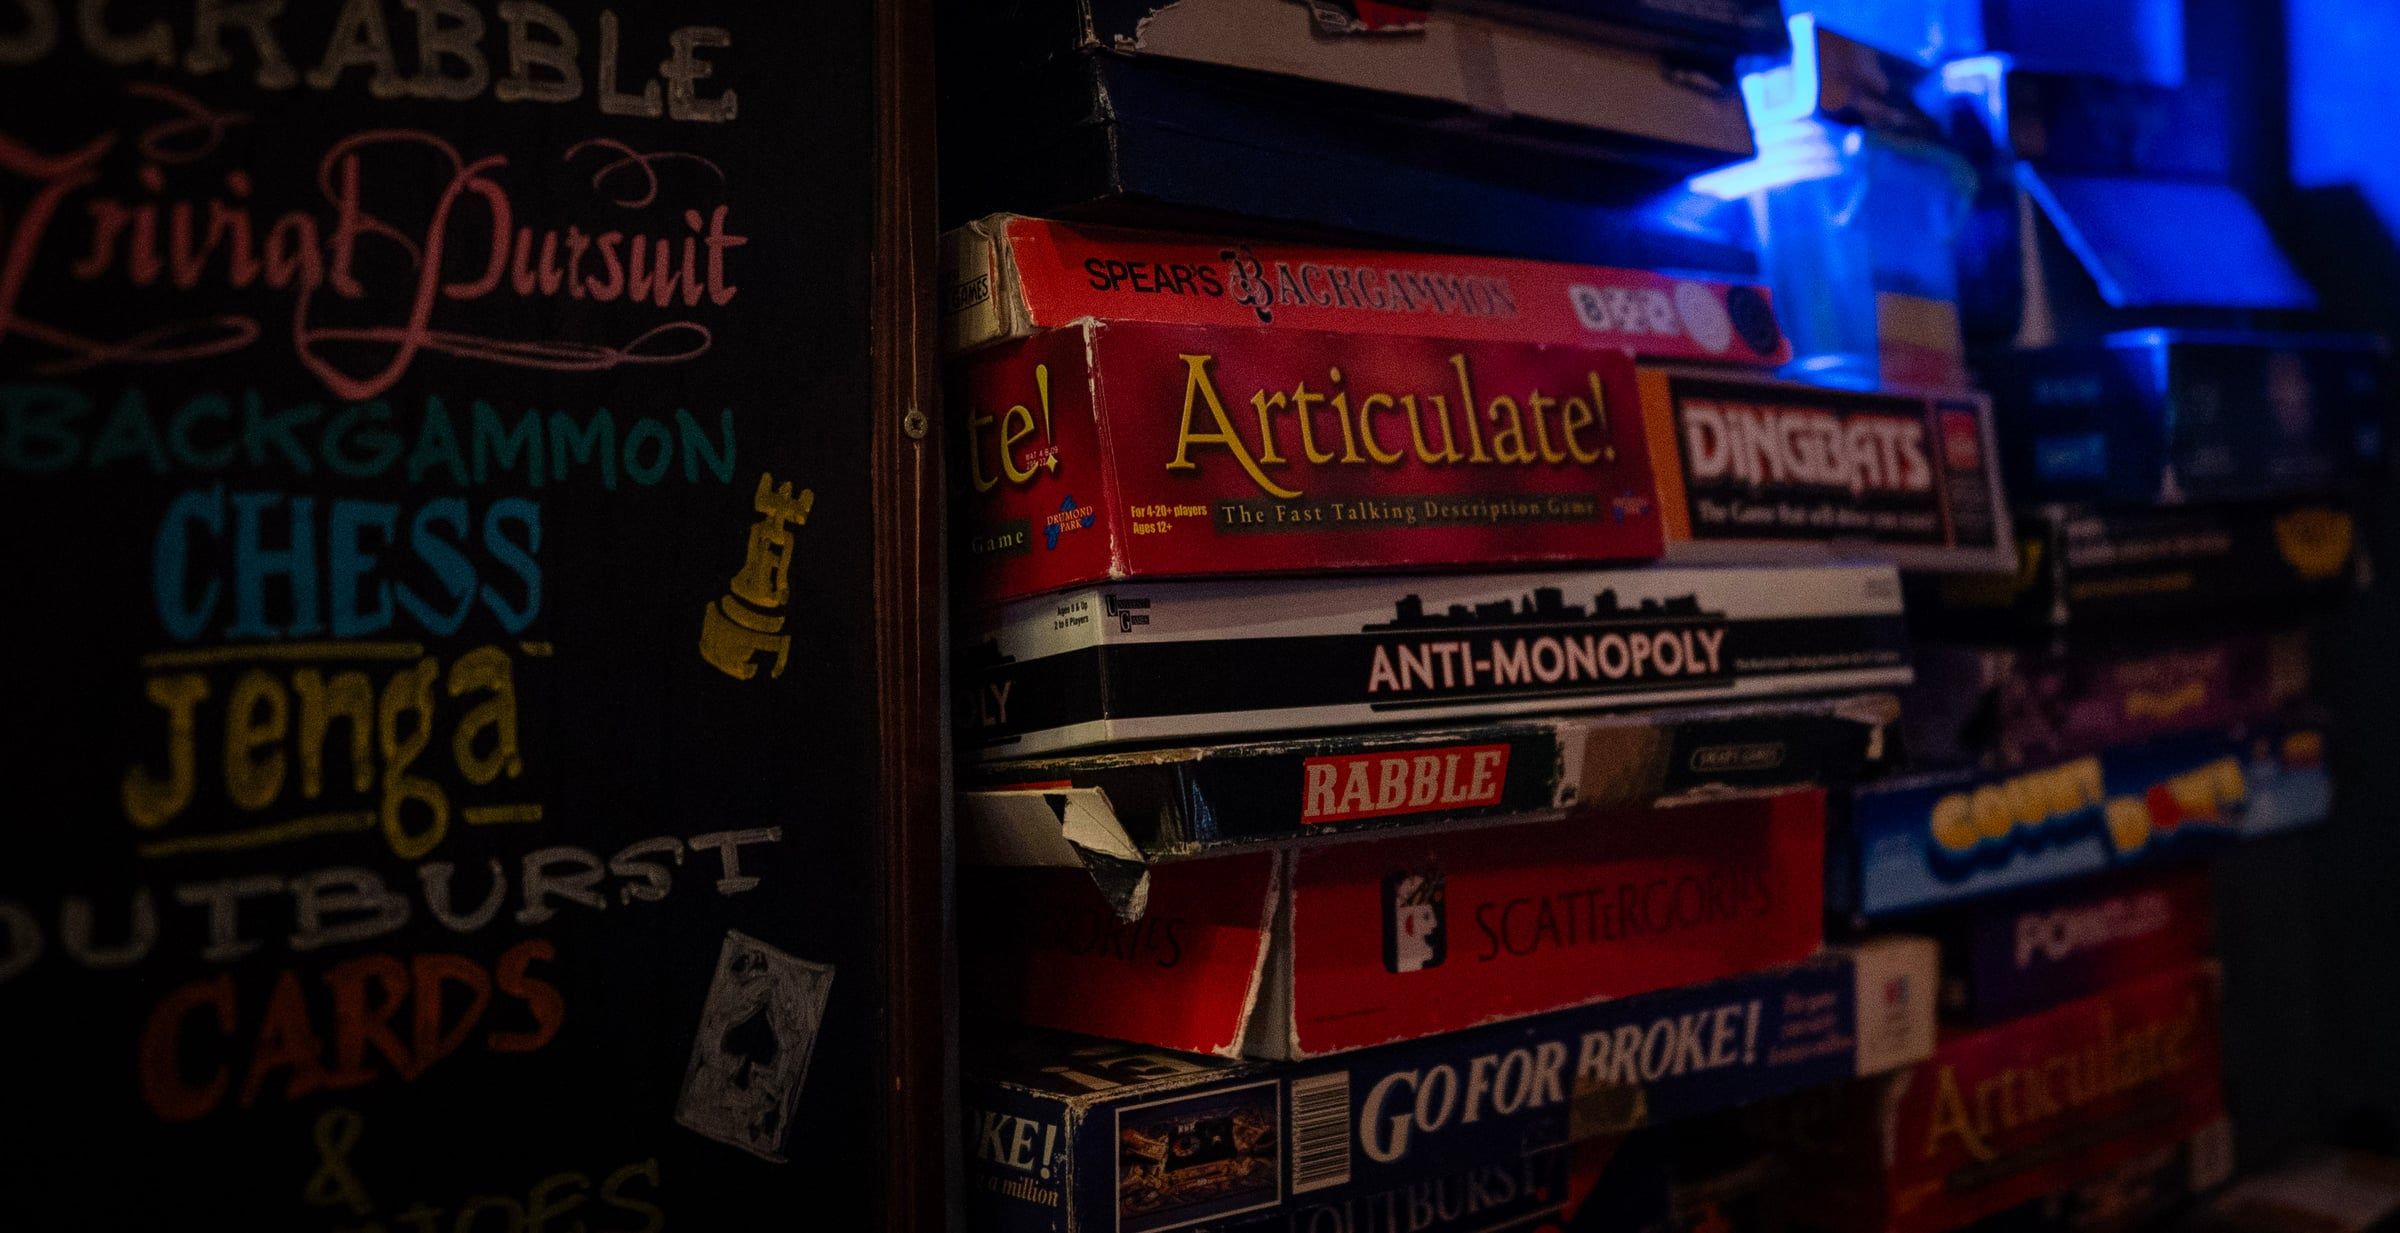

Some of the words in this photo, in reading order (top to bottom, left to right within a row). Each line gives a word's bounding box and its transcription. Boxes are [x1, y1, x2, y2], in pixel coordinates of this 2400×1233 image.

[0, 128, 368, 340] Trivial
[390, 150, 748, 365] Pursuit
[1085, 256, 1224, 298] SPEAR'S
[1227, 246, 1519, 322] BACKGAMMON
[0, 382, 738, 491] BACKGAMMON
[1166, 353, 1616, 498] Articulate!
[1682, 402, 1932, 497] DINGBATS
[1047, 505, 1094, 526] DRUMOND
[1060, 519, 1083, 533] PARK
[1130, 505, 1145, 518] For
[1147, 504, 1172, 518] 4-20+
[1174, 504, 1208, 518] players
[1133, 521, 1156, 535] Ages
[1157, 520, 1173, 533] 12+
[1221, 504, 1265, 527] The
[1276, 502, 1324, 524] Fast
[1331, 500, 1416, 526] Talking
[1422, 498, 1541, 524] Description
[1546, 499, 1596, 518] Game
[151, 482, 544, 641] CHESS
[1070, 615, 1089, 627] Players
[1366, 627, 1728, 694] ANTI-MONOPOLY
[120, 644, 525, 861] Jenga
[1304, 748, 1503, 817] RABBLE
[136, 937, 567, 1125] CARDS
[1358, 1063, 1458, 1165] GO
[1460, 1037, 1569, 1125] FOR
[1575, 998, 1763, 1088] BROKE!
[303, 1105, 379, 1214] &
[1001, 1176, 1060, 1208] million
